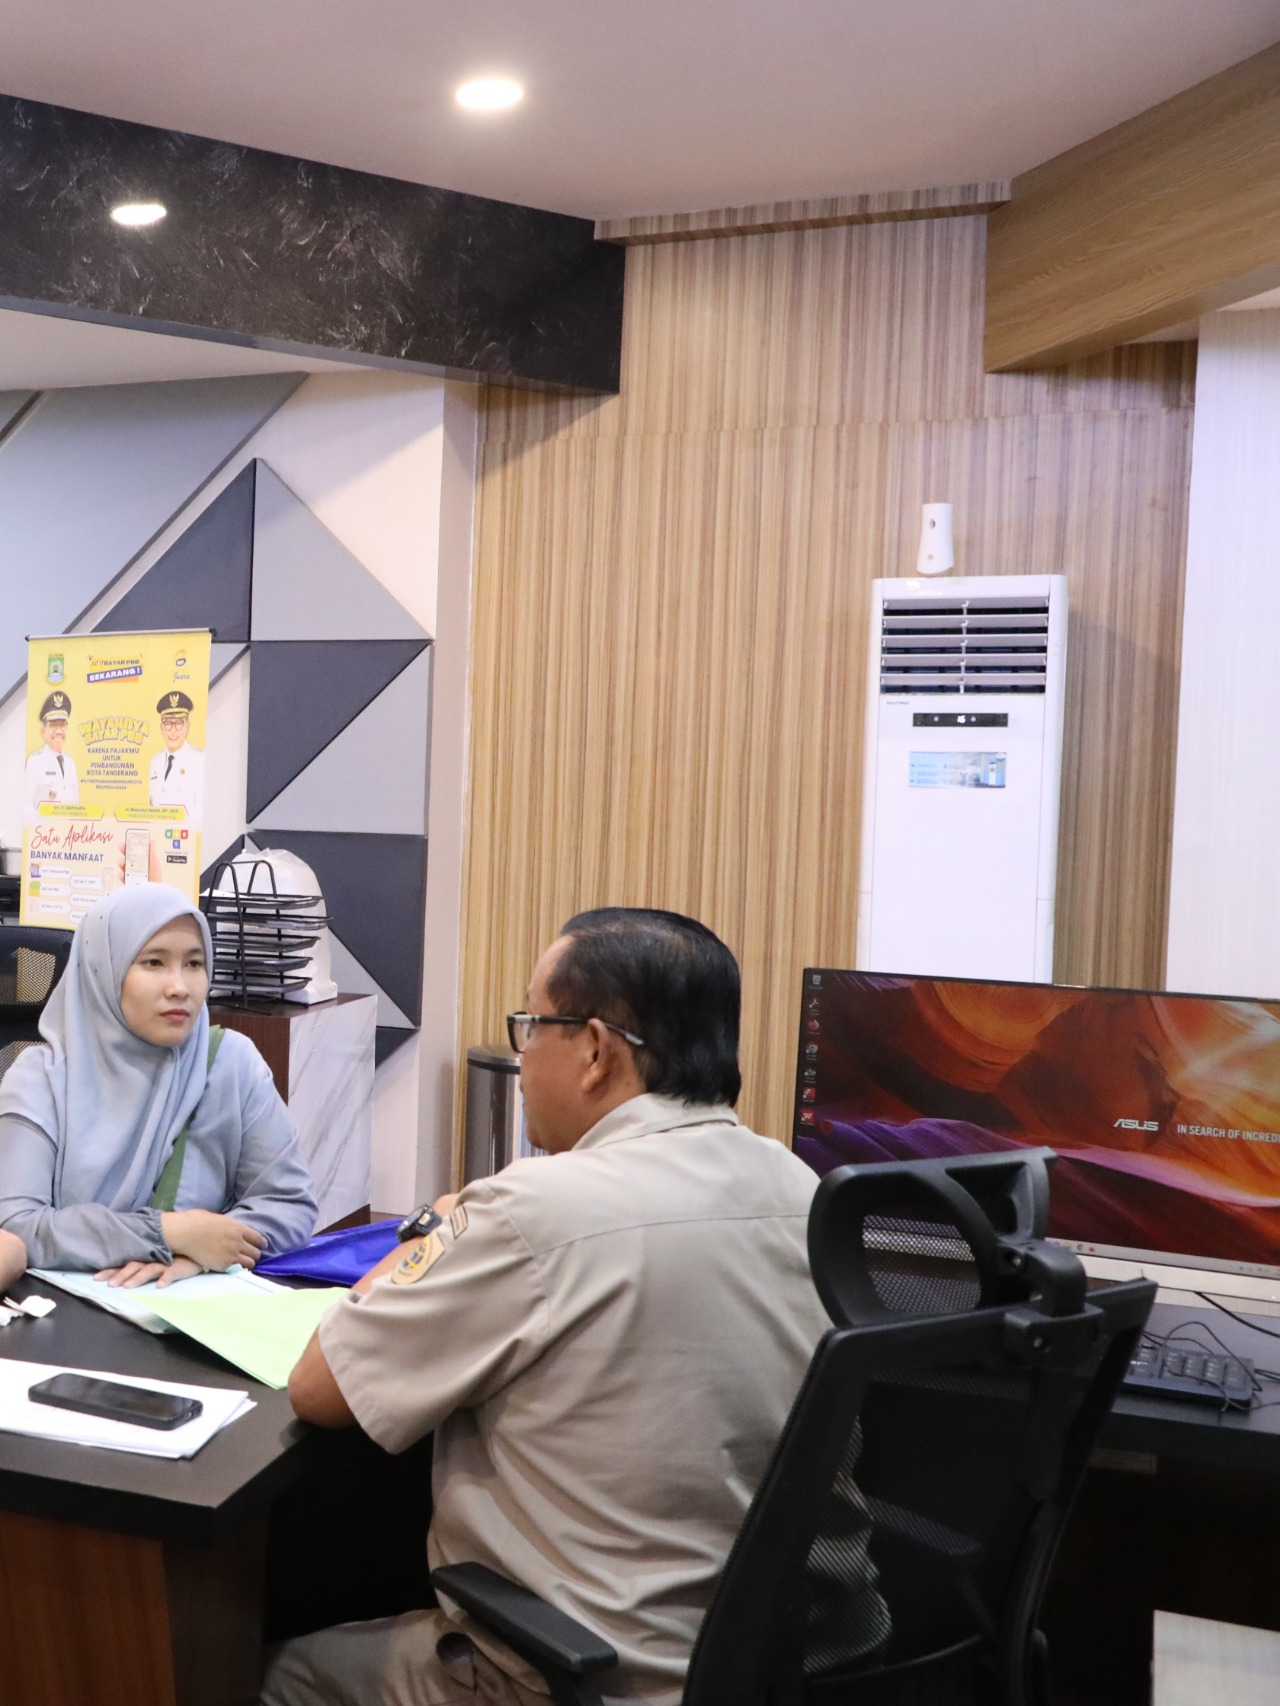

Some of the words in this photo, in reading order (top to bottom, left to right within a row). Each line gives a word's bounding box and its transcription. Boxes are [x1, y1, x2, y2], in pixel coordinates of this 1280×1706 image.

[89, 667, 136, 682] SEKARANG
[31, 825, 61, 850] Satu
[62, 823, 114, 851] Aplikasi
[30, 850, 63, 861] BANYAK
[64, 852, 104, 863] MANFAAT
[1113, 1118, 1159, 1132] ASUS
[1177, 1124, 1187, 1134] IN
[1189, 1125, 1226, 1138] SEARCH
[1228, 1129, 1240, 1139] OF
